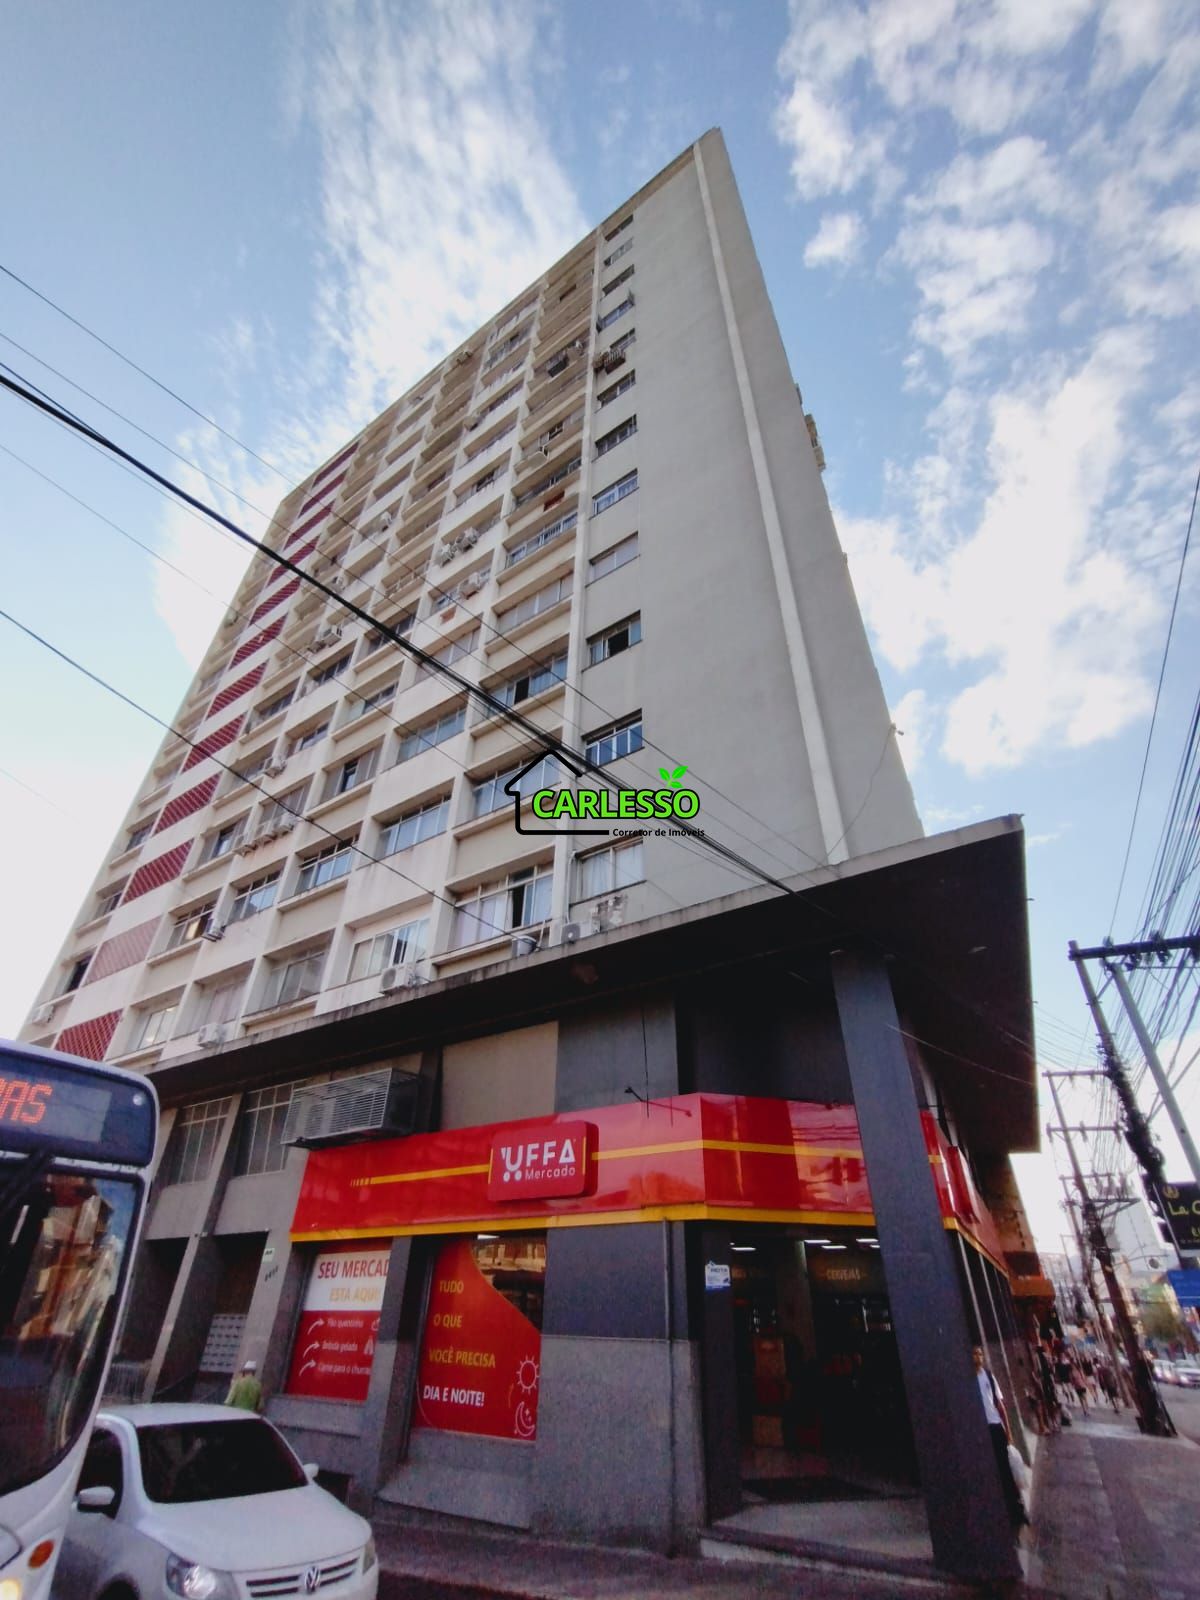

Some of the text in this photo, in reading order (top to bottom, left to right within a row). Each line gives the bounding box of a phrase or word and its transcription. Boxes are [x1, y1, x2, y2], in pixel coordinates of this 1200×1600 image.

[525, 1165, 576, 1180] Mercado
[317, 1261, 340, 1279] SEU
[440, 1280, 464, 1295] TUDO
[433, 1313, 463, 1329] O QUE
[429, 1346, 497, 1368] VOCÊ PRECISA
[423, 1385, 486, 1407] DIA E NOITE!
